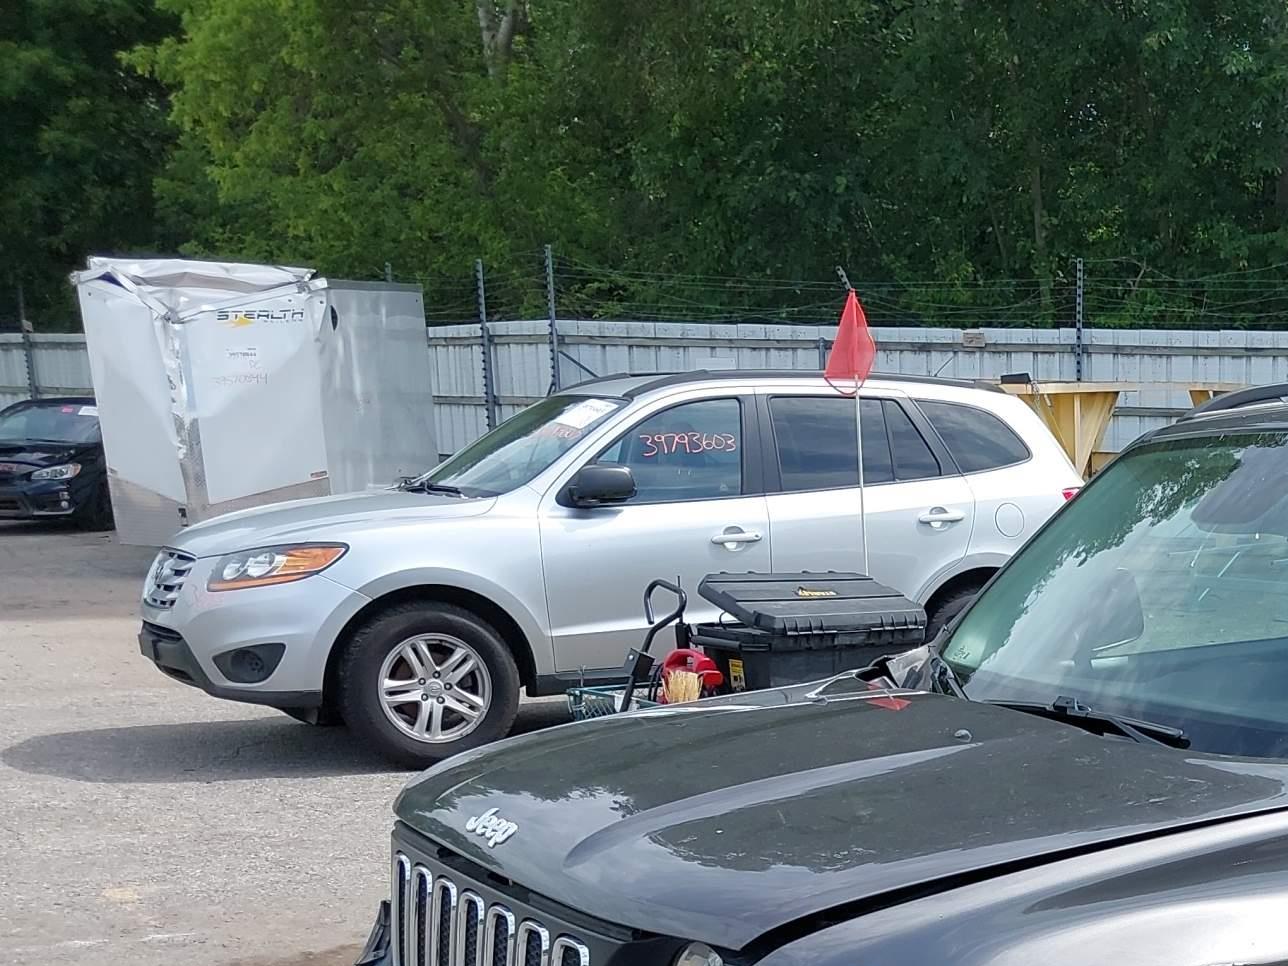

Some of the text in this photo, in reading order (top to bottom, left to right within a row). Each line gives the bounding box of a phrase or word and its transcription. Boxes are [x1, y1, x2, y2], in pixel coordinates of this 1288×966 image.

[217, 307, 304, 321] STEALTH
[639, 431, 736, 457] 39793603
[465, 807, 519, 848] Jeep
